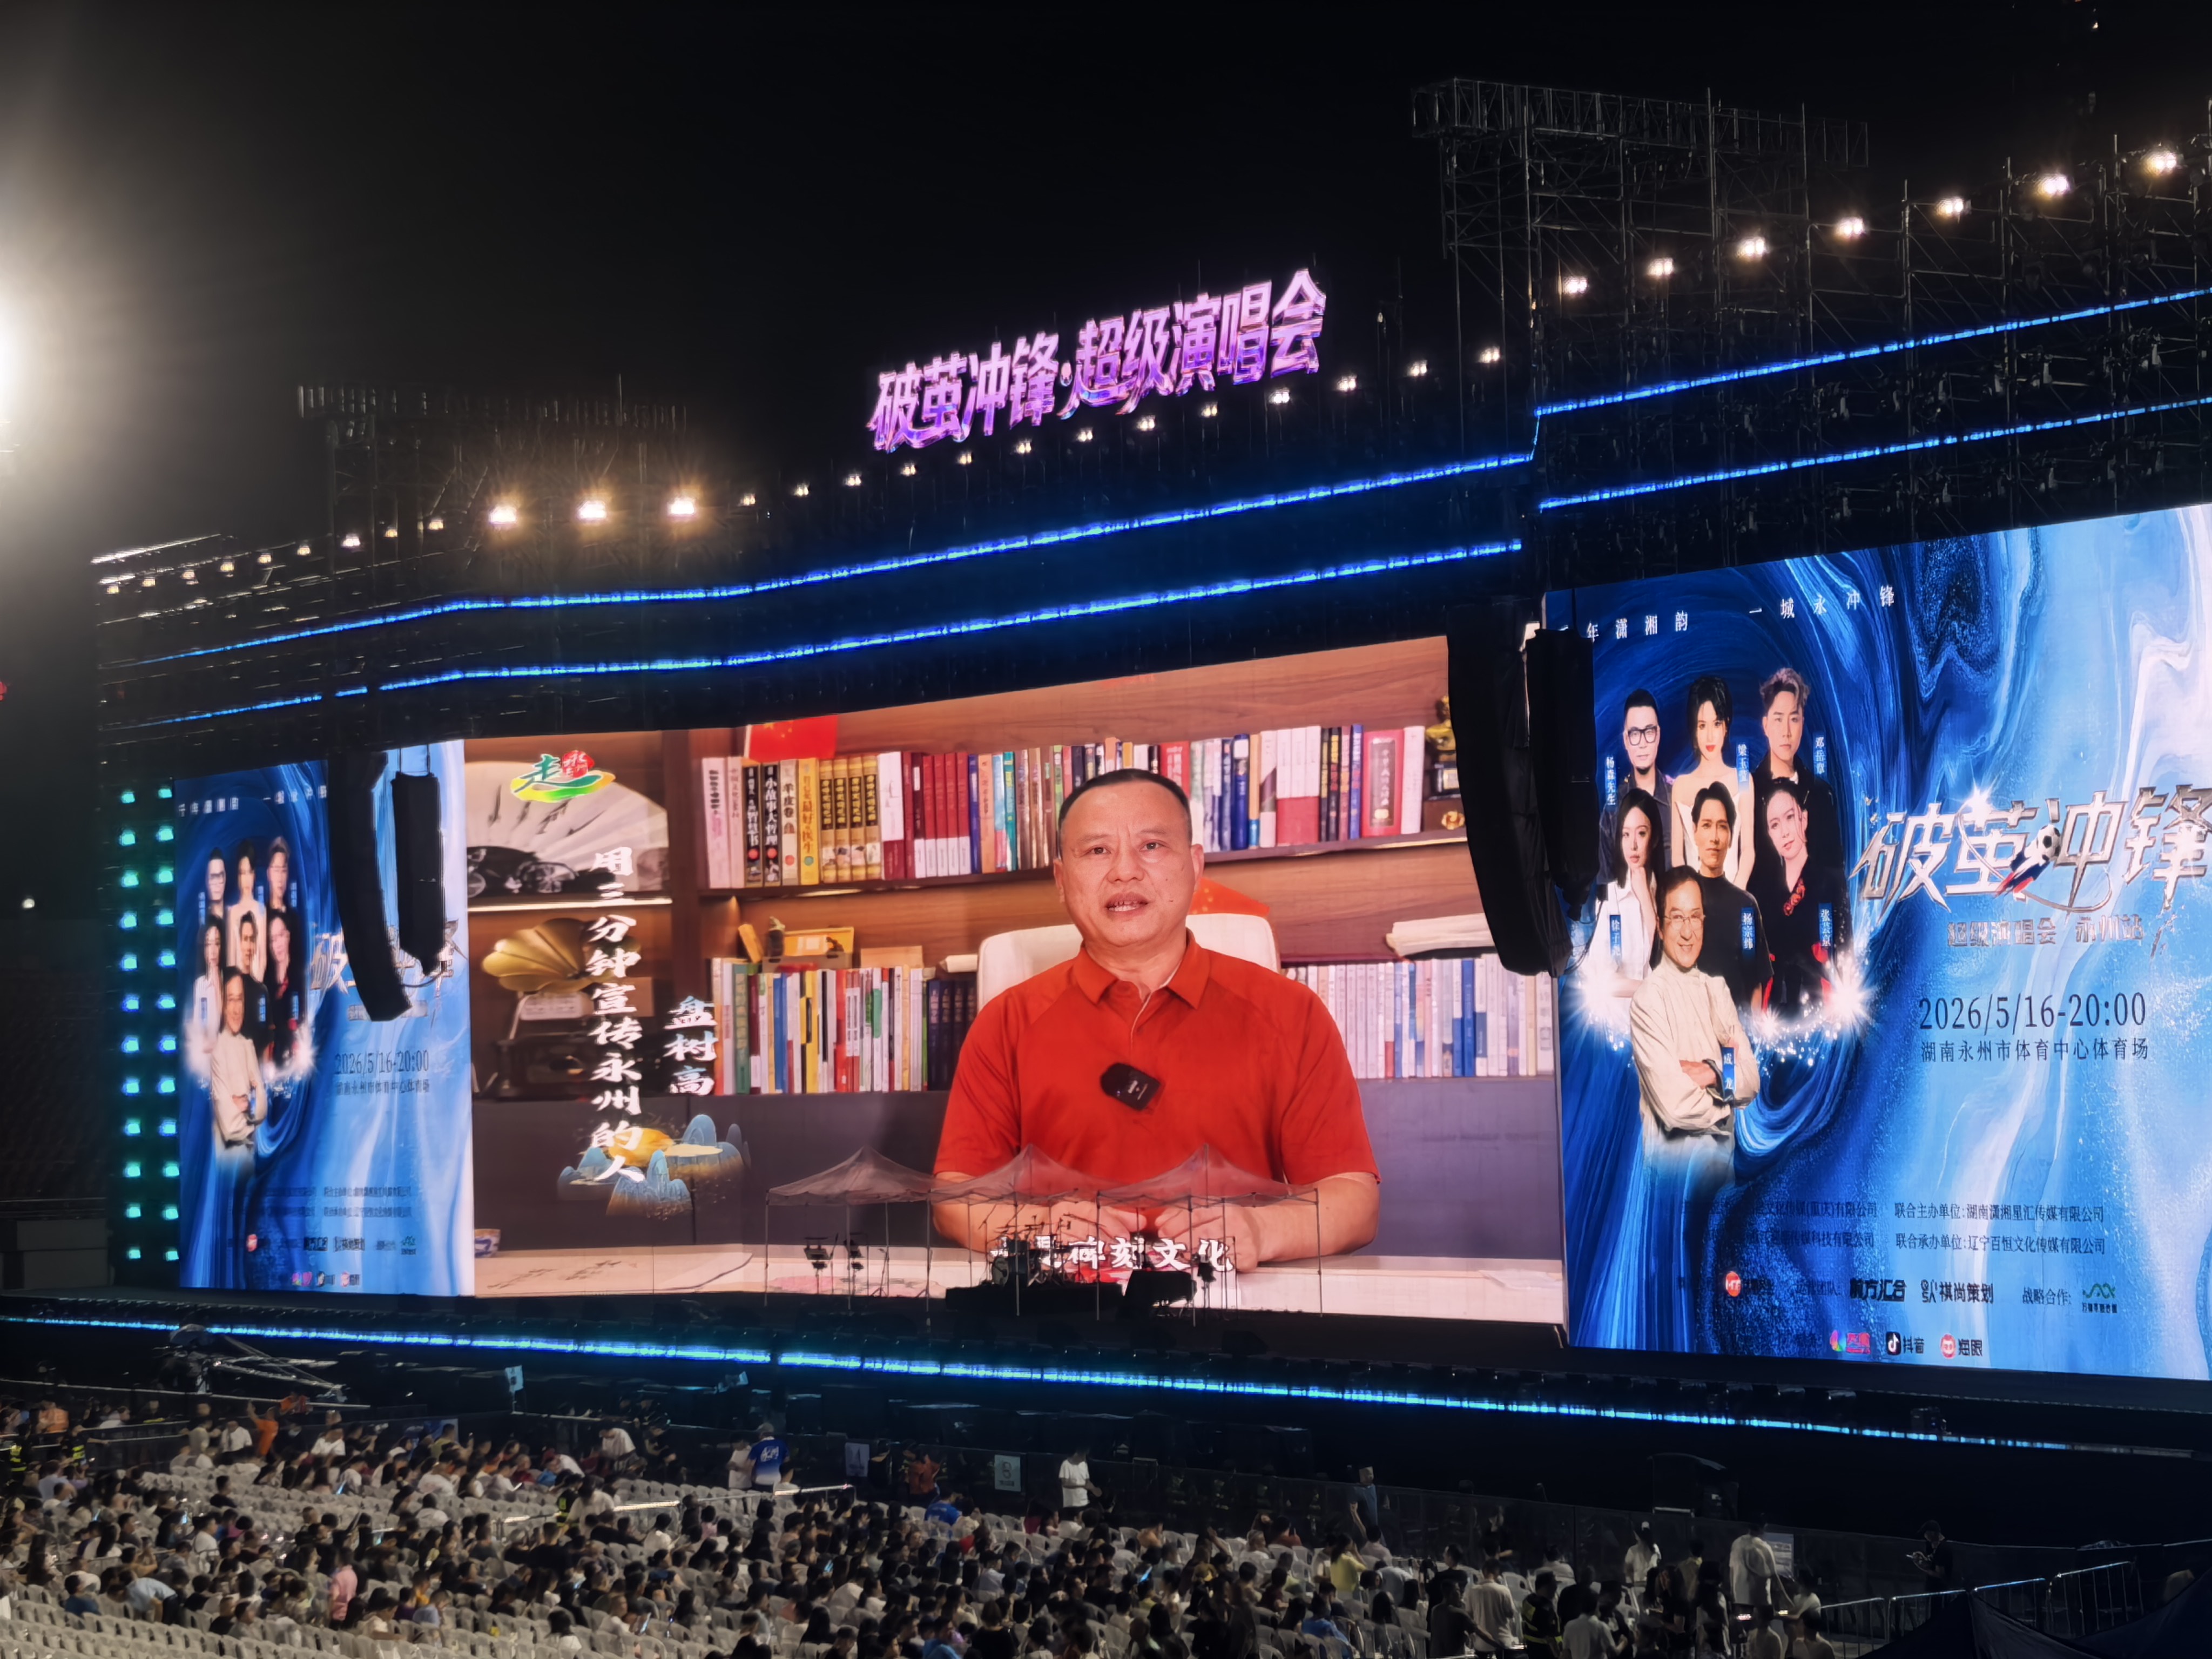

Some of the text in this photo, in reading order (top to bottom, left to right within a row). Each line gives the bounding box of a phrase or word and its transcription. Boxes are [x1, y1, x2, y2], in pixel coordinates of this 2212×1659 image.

[867, 268, 1326, 453] 破茧冲锋·超级演唱会
[1557, 585, 1895, 643] 年潇湘韵 一城永冲锋
[1849, 784, 2212, 922] 破茧冲锋
[1947, 917, 2057, 947] 超级演唱会
[585, 846, 645, 1182] 用三分钟宣传永州的人
[1919, 992, 2147, 1035] 2026/5/16-20:00
[334, 1049, 429, 1077] 2026/5/16-20:00
[663, 995, 717, 1097] 盘树高
[1921, 1037, 2149, 1062] 湖南永州市体育中心体育场
[1904, 1335, 1925, 1354] 抖音
